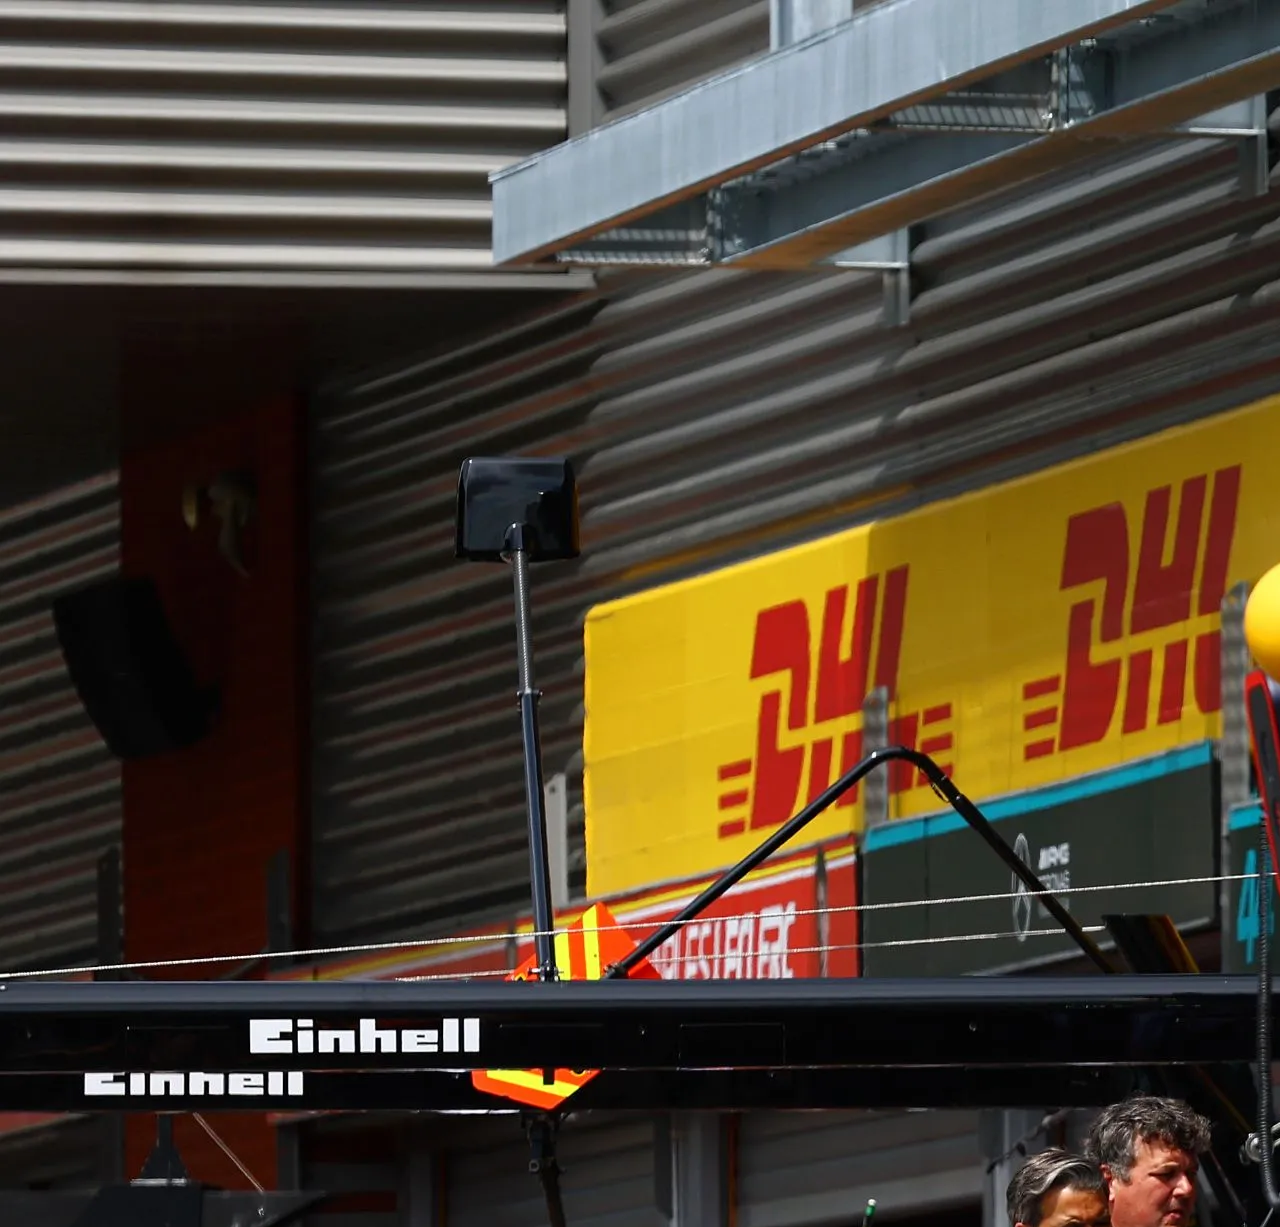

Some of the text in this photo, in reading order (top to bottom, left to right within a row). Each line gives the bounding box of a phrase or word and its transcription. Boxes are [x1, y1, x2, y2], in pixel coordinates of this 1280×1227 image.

[1058, 464, 1243, 750] DHL
[750, 564, 919, 831] DHL
[84, 1072, 303, 1096] Einhell
[249, 1018, 480, 1054] Einhell
